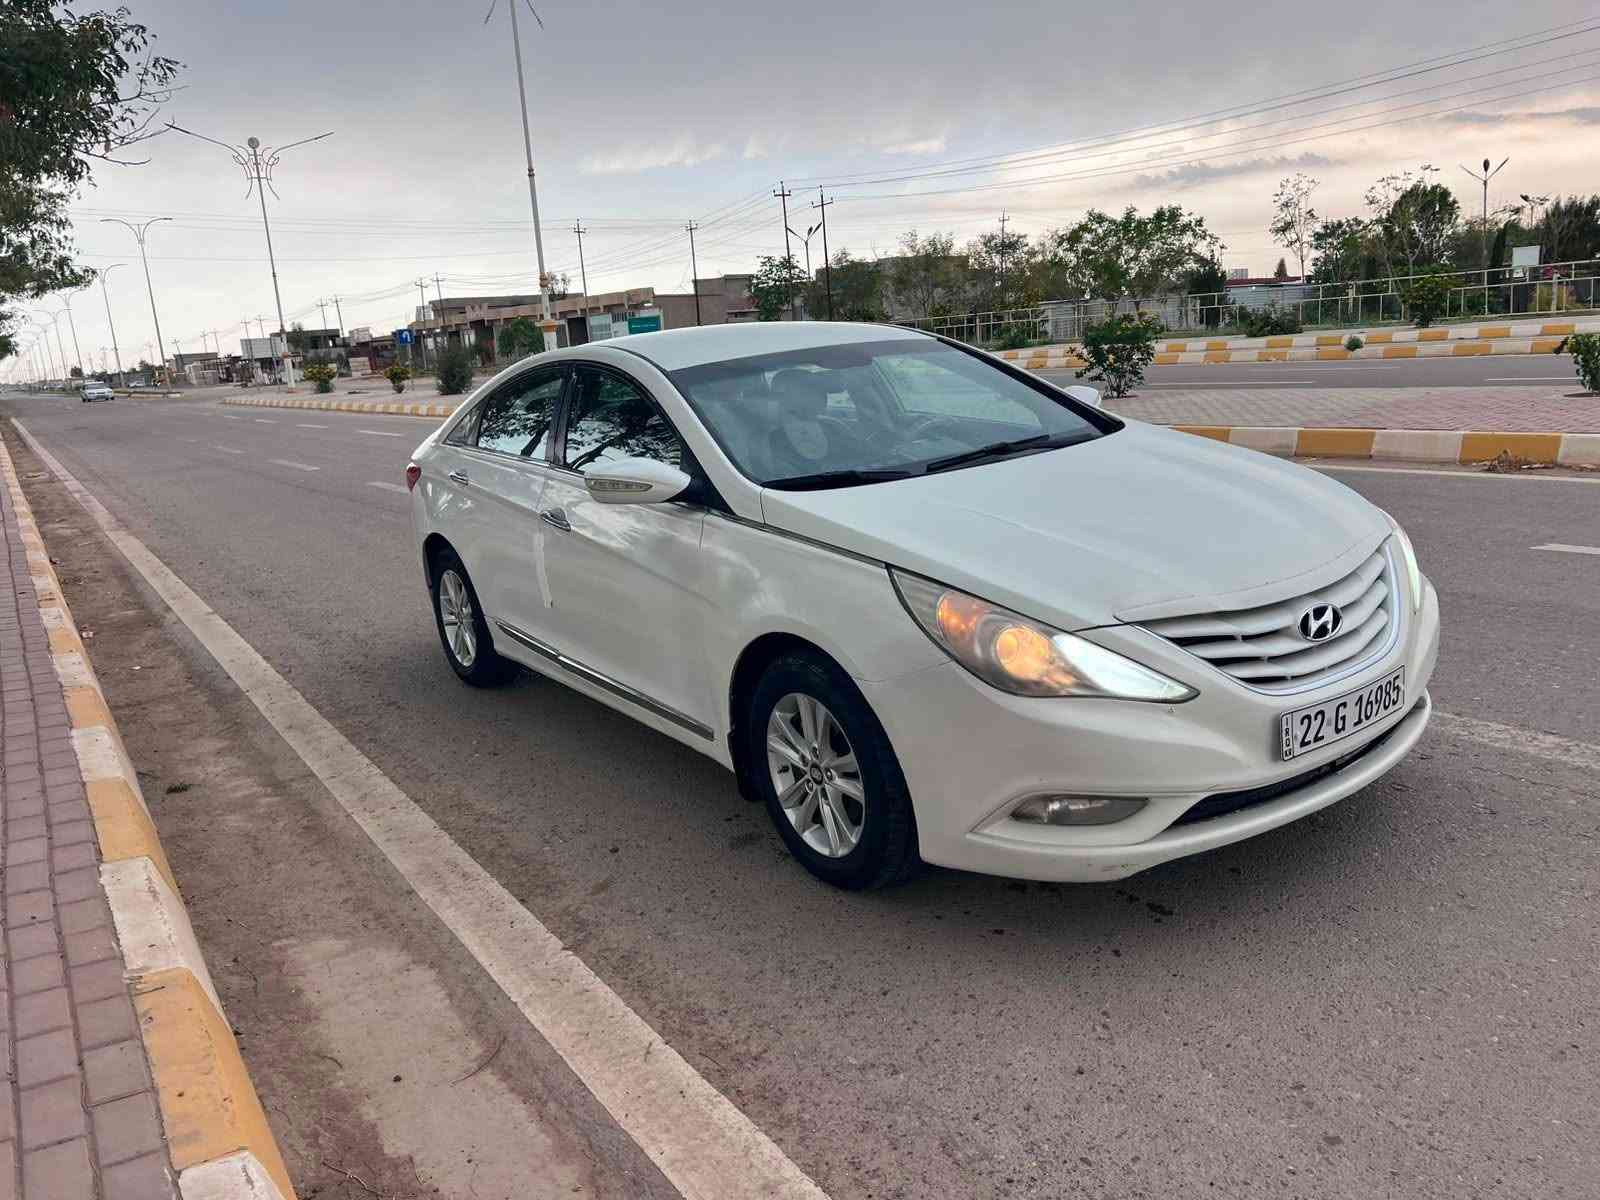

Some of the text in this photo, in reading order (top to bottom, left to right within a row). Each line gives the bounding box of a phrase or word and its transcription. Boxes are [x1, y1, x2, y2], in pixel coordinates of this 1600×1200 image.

[1299, 674, 1401, 748] 22 G 16985
